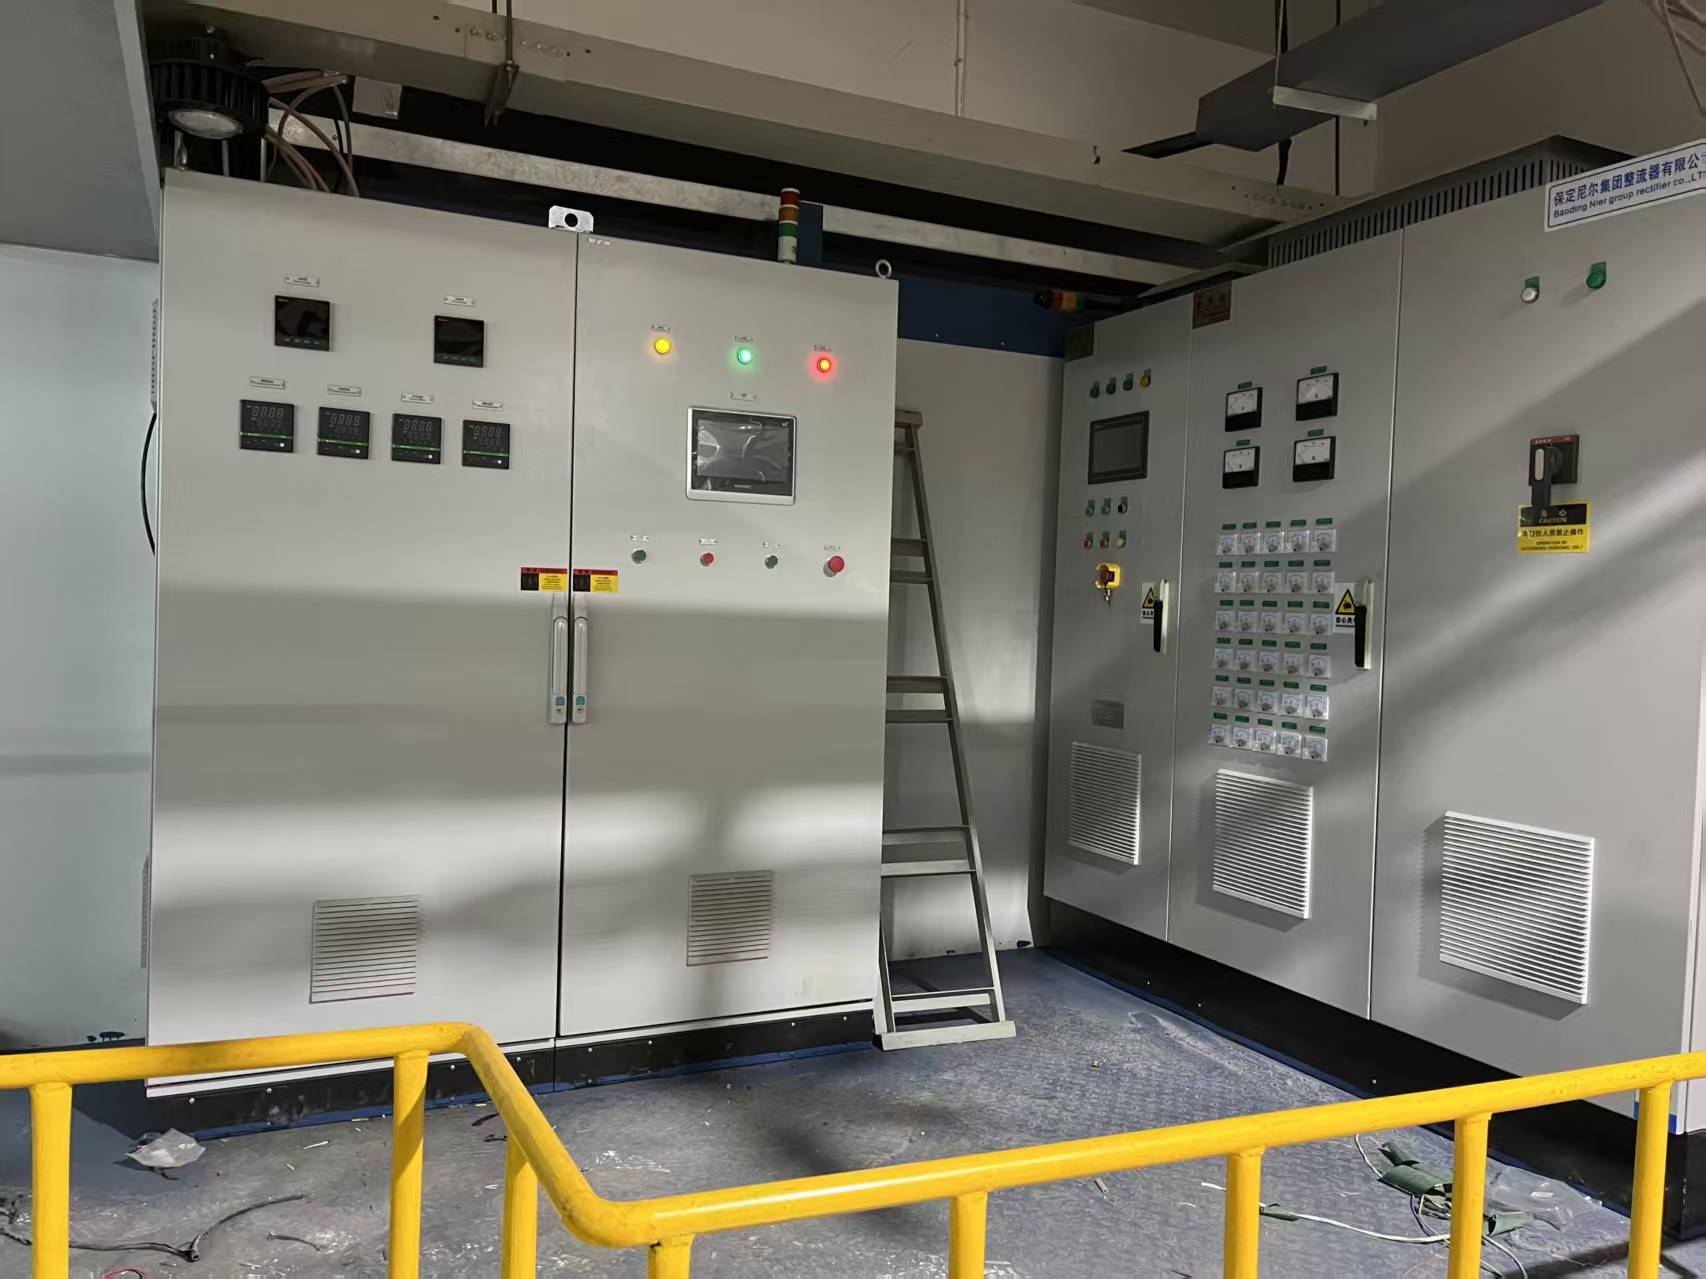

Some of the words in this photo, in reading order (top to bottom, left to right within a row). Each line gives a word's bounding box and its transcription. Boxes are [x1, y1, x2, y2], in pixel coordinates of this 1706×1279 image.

[1554, 152, 1706, 207] 保定尼尔集团整流器有限公
[1554, 203, 1588, 218] Baoding
[1608, 190, 1634, 205] group
[1635, 181, 1671, 197] rectifier
